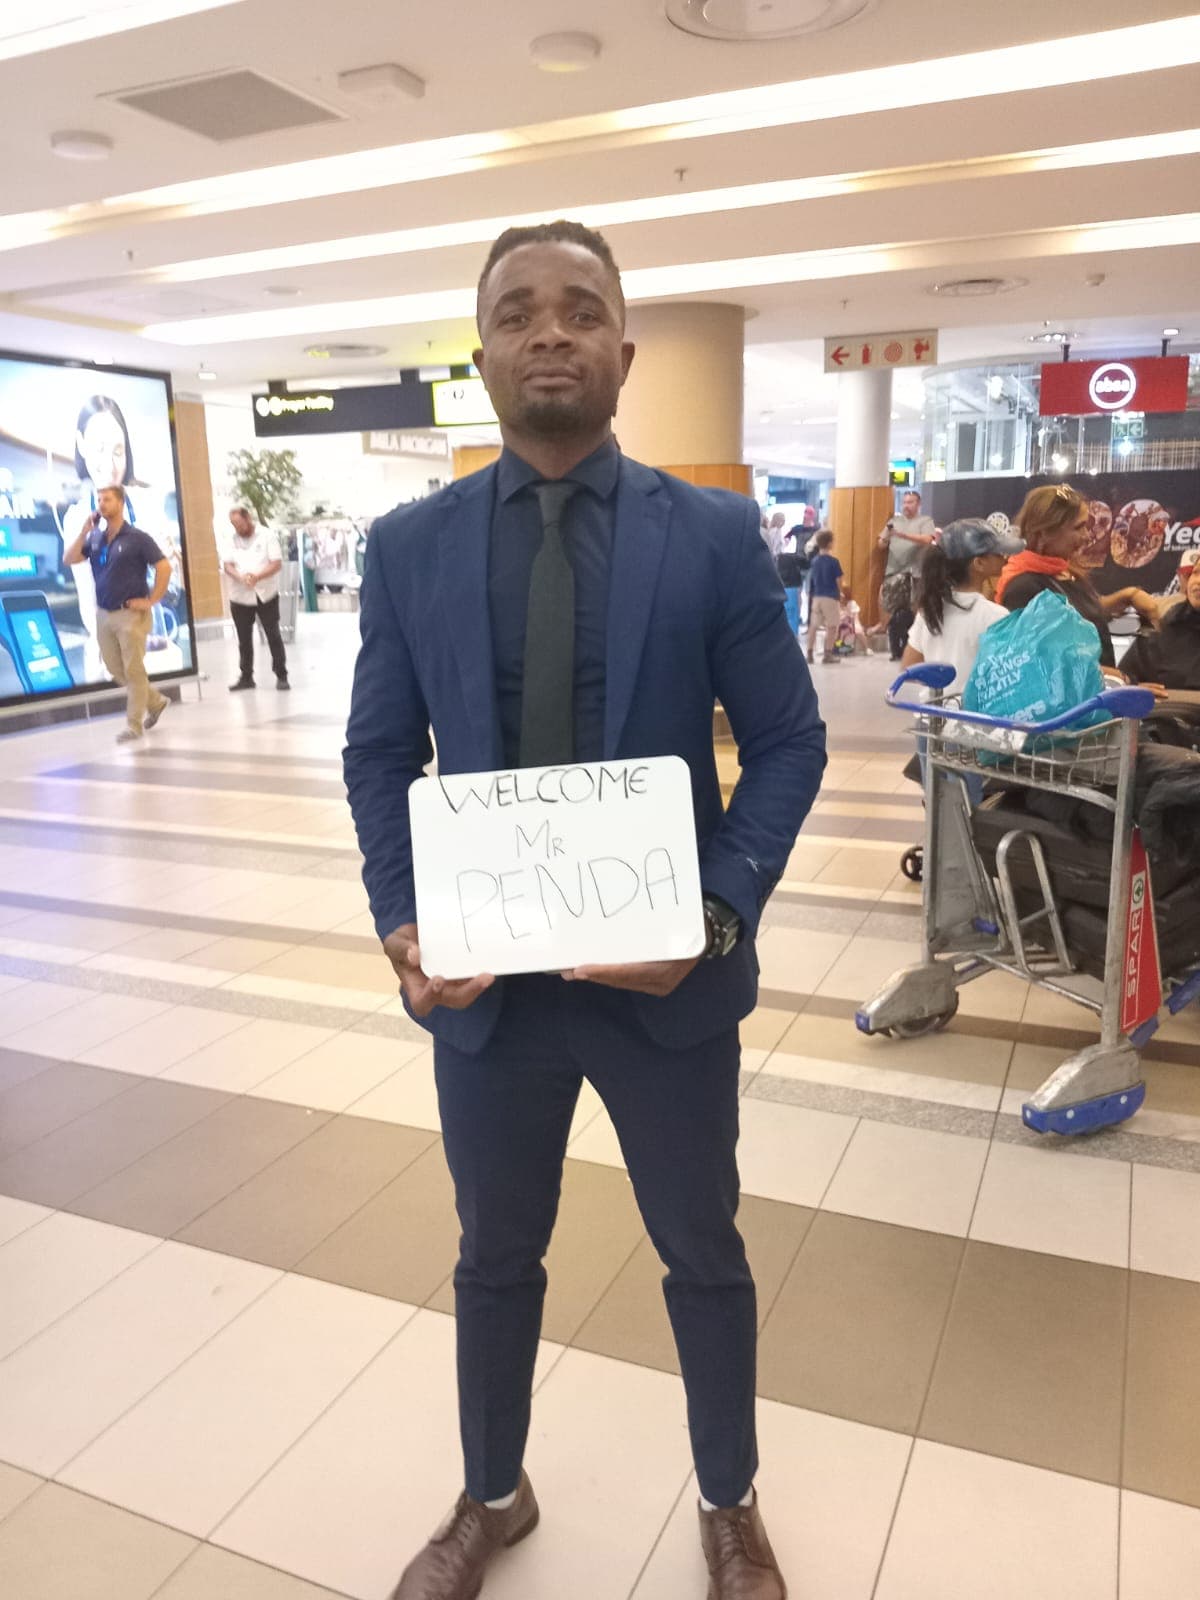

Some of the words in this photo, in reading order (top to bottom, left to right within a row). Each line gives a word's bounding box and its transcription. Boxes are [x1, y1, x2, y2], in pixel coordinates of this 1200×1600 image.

[439, 766, 649, 813] WELCOME
[456, 847, 679, 953] PENDA
[1127, 910, 1141, 998] SPAR
